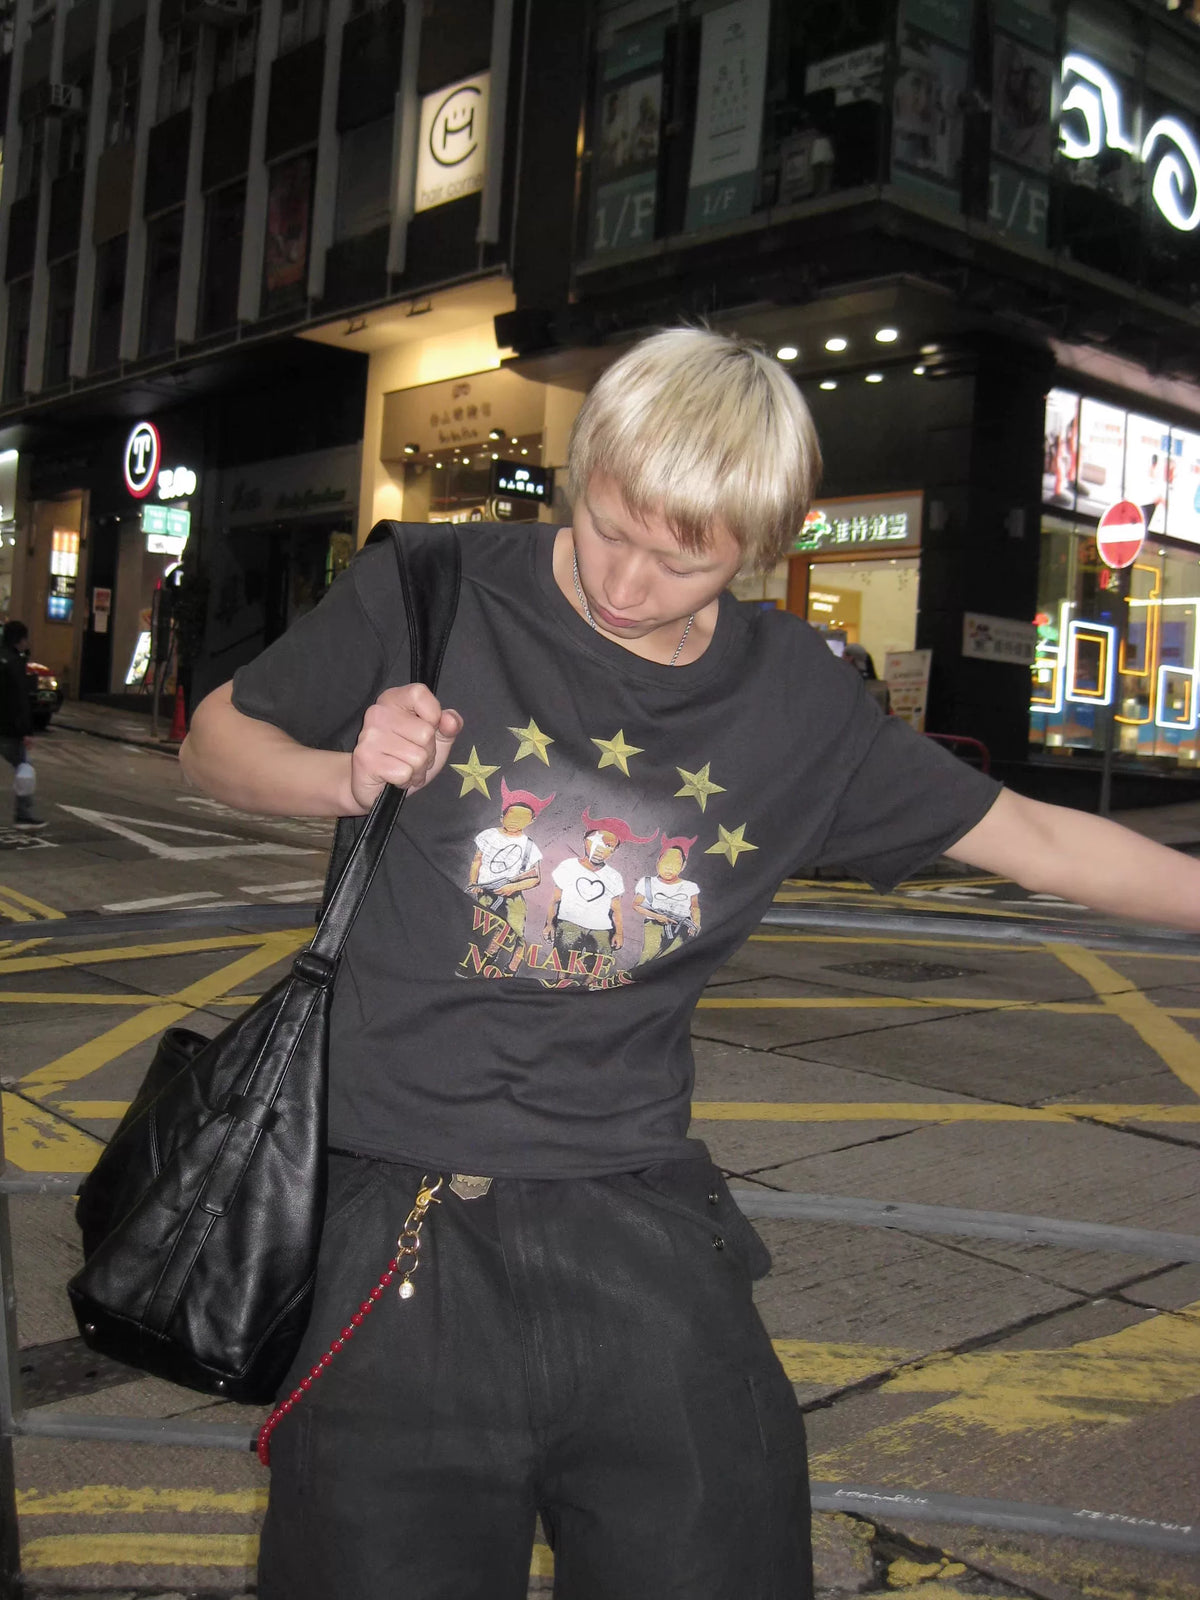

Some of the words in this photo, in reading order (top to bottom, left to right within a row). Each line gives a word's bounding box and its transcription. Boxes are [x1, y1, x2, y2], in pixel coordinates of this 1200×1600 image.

[594, 190, 656, 249] 1/F
[703, 186, 737, 217] 1/F
[989, 173, 1048, 235] 1/F
[472, 905, 520, 952] WE
[520, 943, 616, 980] MAKE
